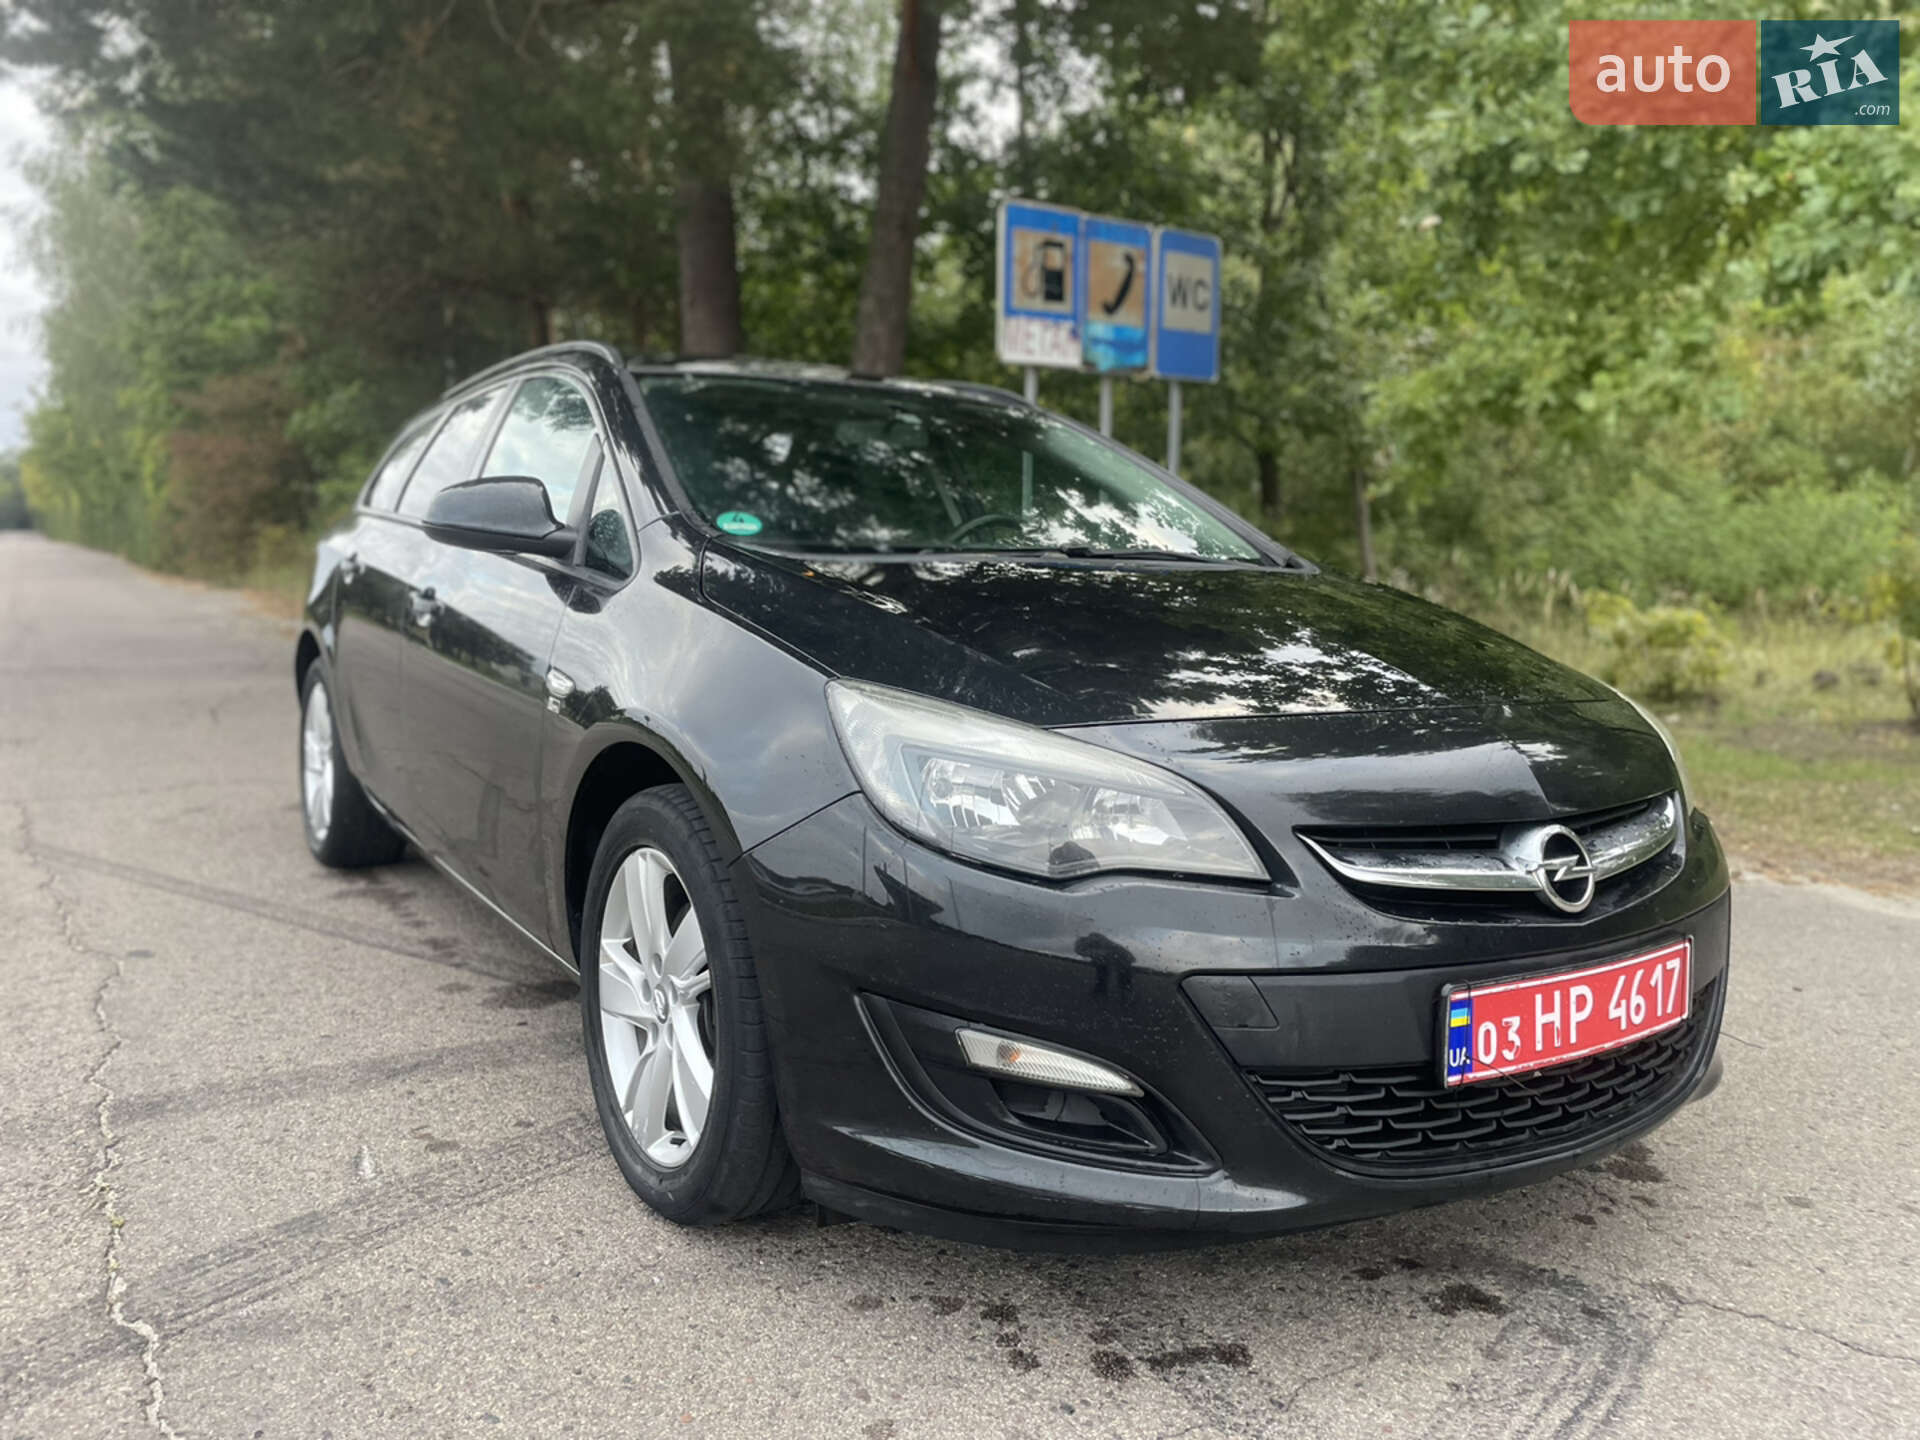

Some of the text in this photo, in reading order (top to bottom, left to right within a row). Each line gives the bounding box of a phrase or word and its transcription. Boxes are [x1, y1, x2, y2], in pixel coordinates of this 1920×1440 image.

[1168, 273, 1211, 312] WC
[1477, 957, 1681, 1065] 03 HP 4617
[1449, 1046, 1471, 1067] UA
